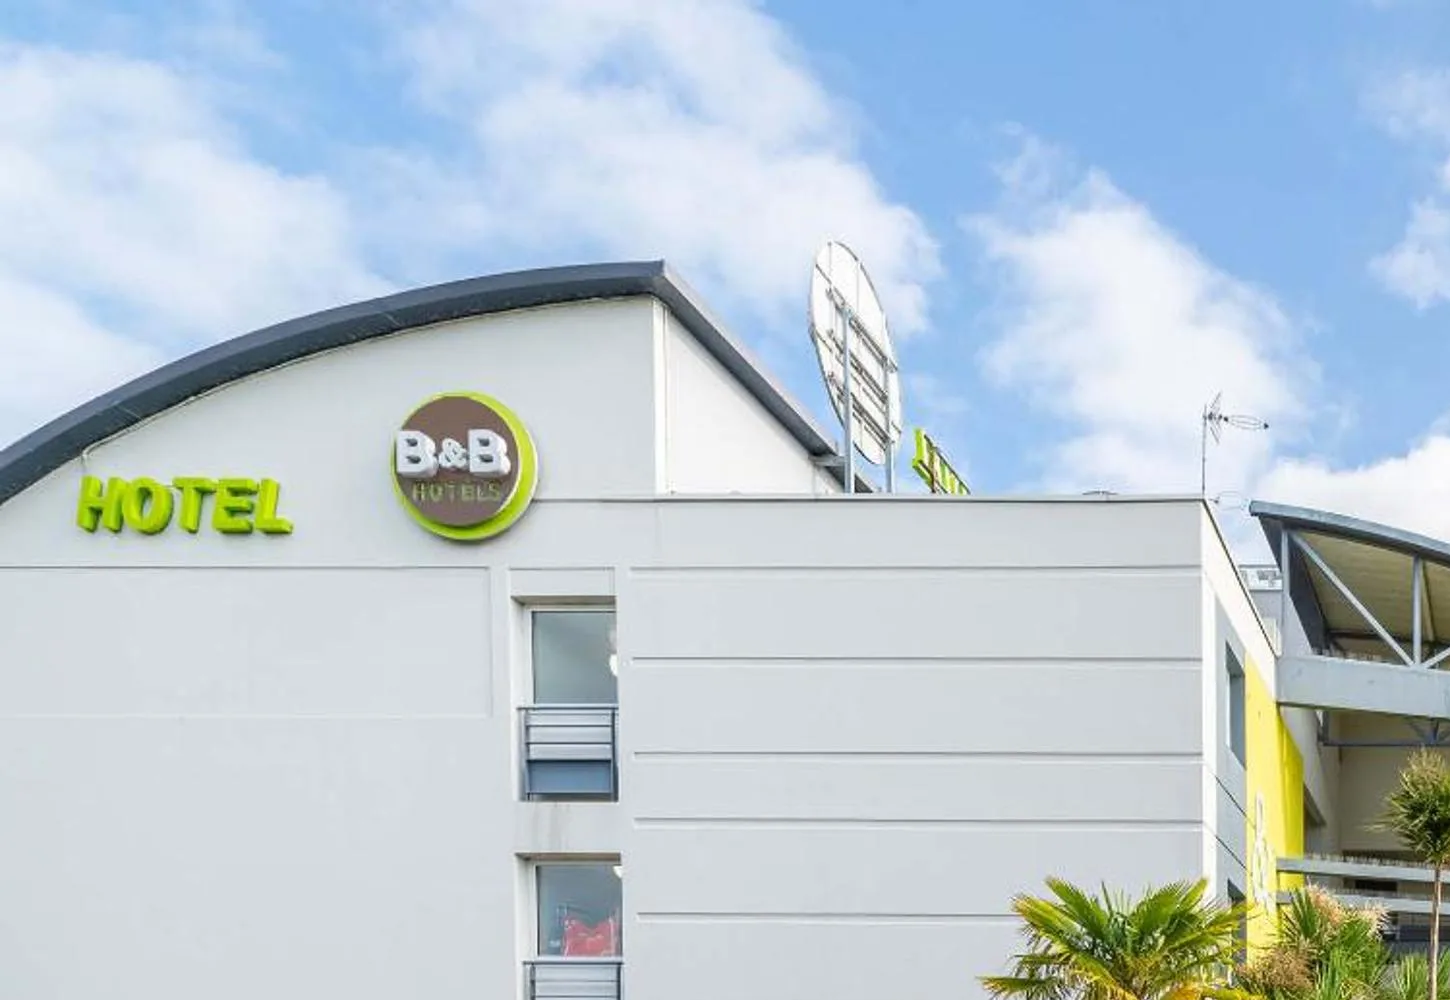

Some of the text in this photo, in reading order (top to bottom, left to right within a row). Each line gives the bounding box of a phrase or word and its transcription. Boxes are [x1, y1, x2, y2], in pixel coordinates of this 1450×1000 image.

[396, 428, 511, 478] B&B
[77, 475, 293, 535] HOTEL
[412, 480, 501, 502] HOTELS
